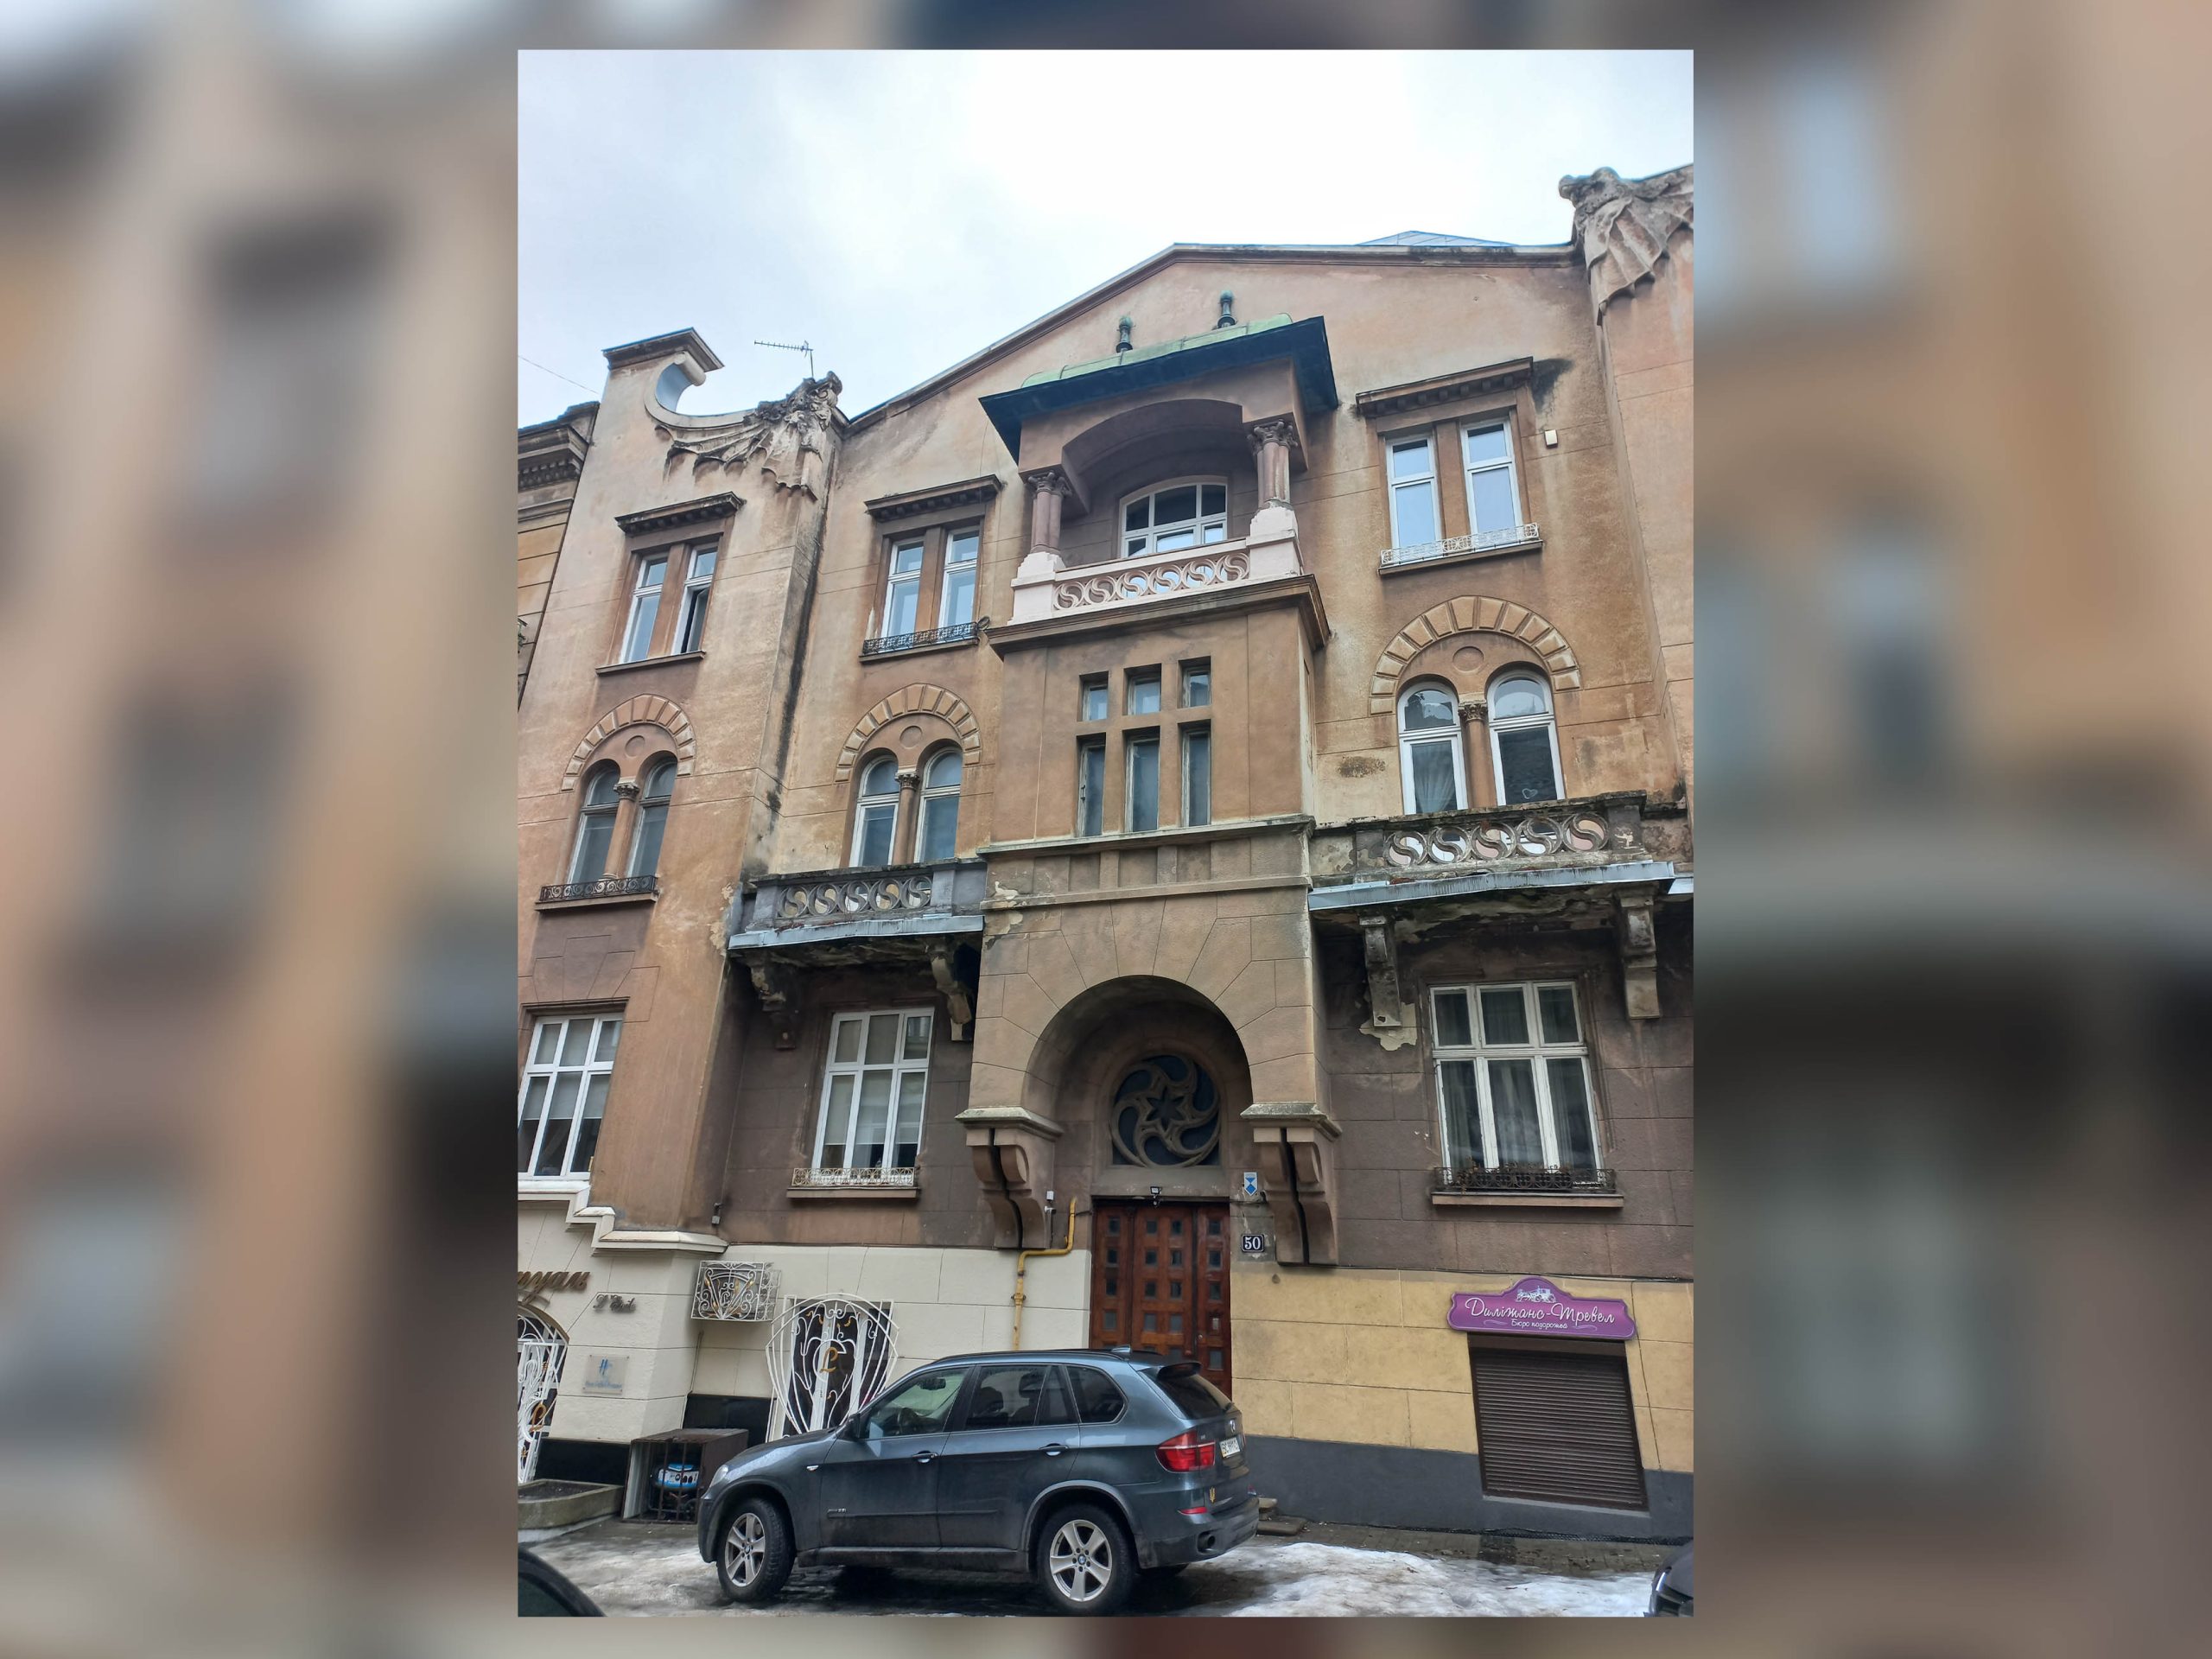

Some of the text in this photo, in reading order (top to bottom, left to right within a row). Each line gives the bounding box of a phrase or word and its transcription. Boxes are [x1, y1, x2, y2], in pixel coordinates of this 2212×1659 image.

[1244, 1236, 1261, 1250] 50
[1465, 1297, 1615, 1325] Диліжанс-Тревел
[1511, 1319, 1530, 1329] Бюро
